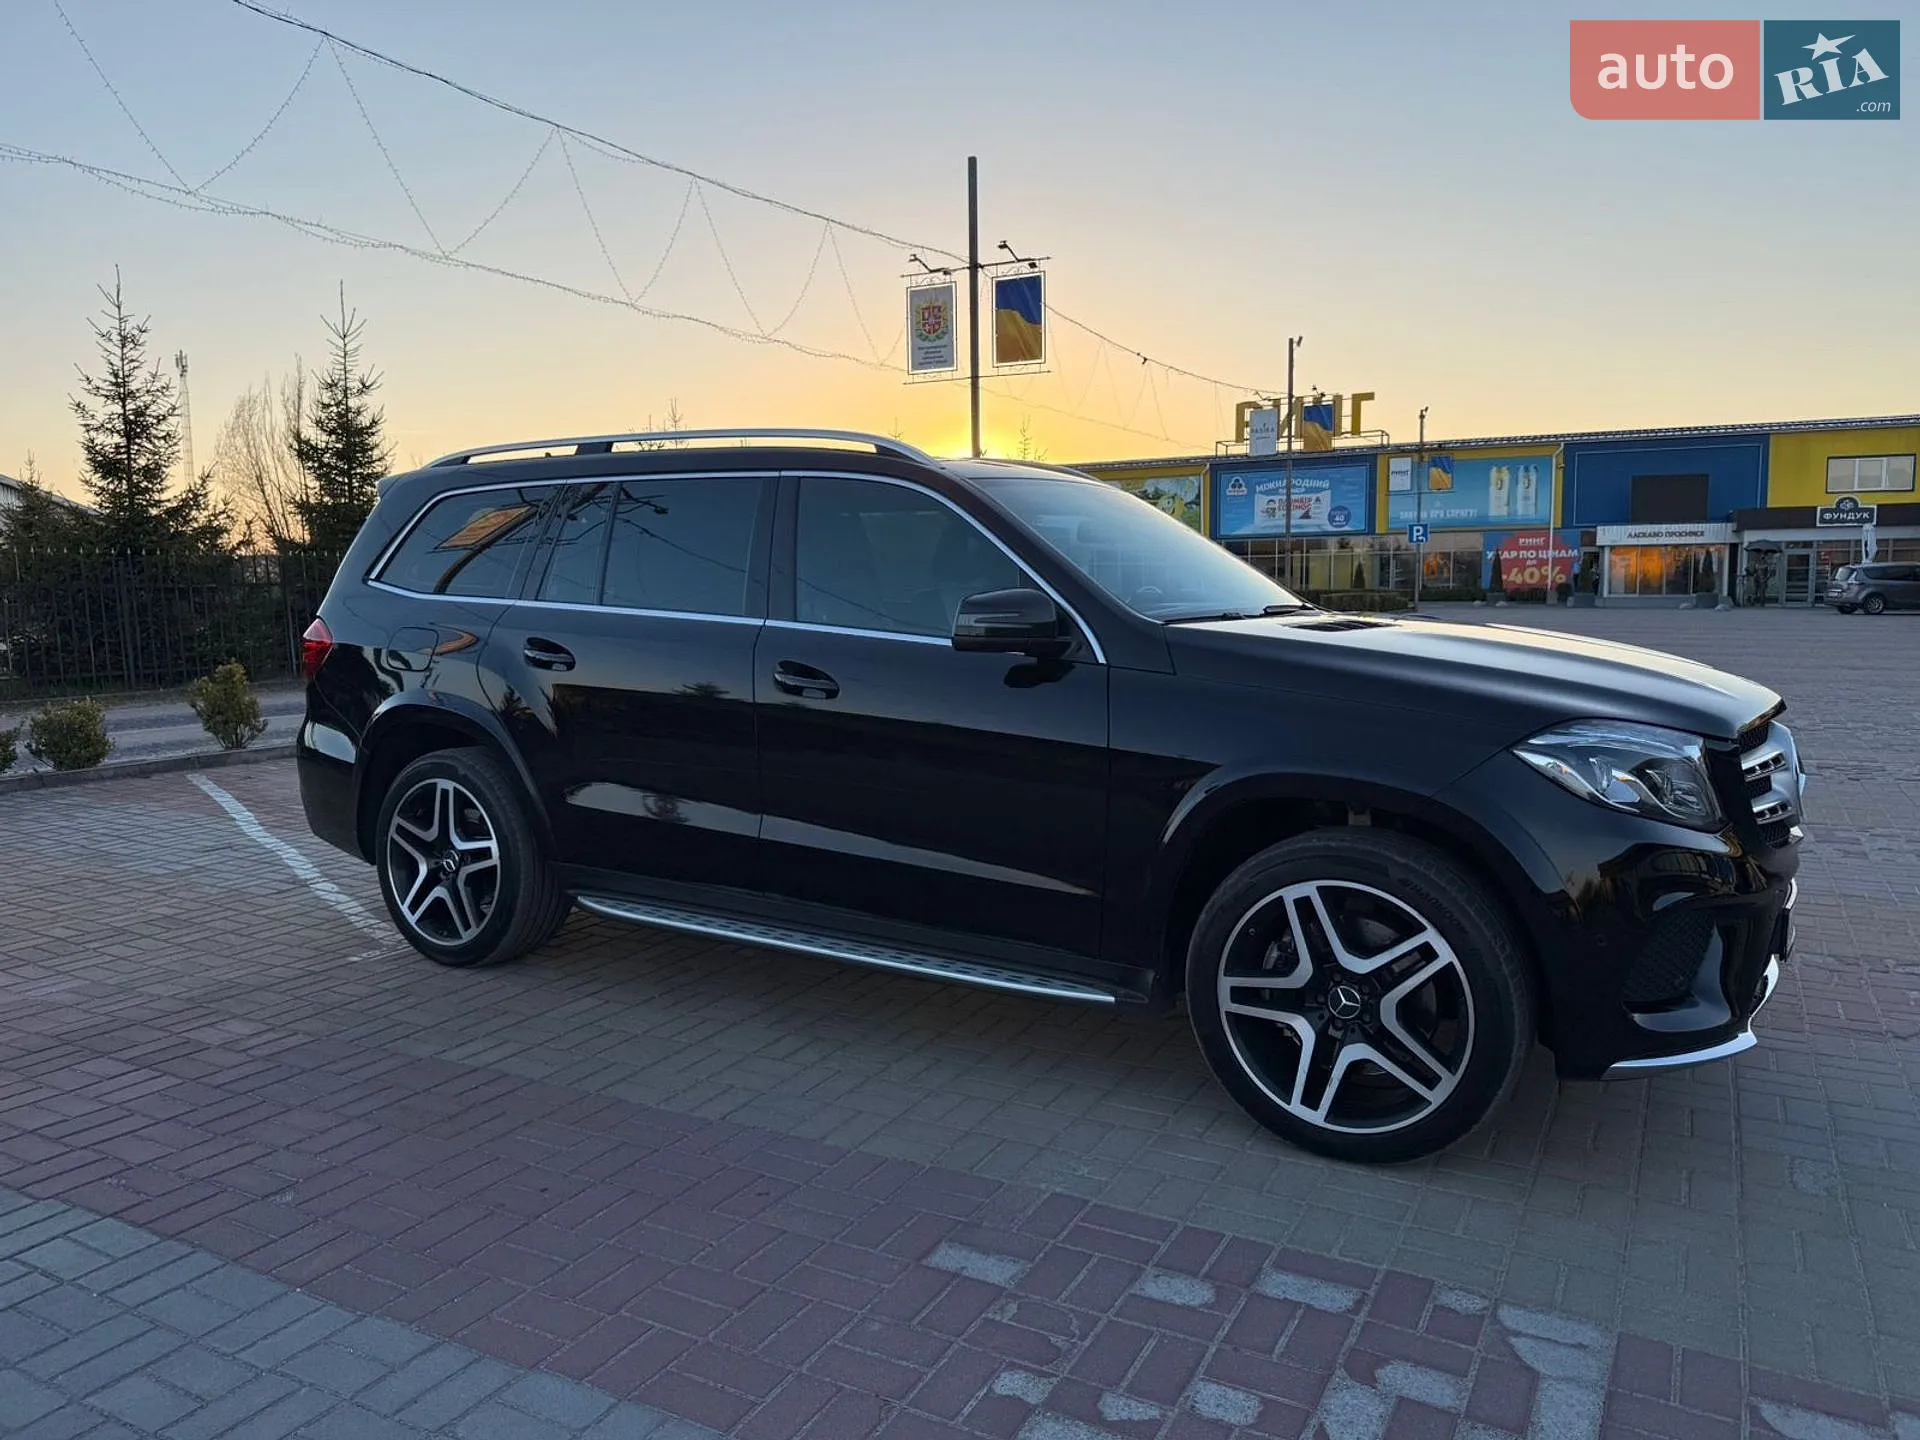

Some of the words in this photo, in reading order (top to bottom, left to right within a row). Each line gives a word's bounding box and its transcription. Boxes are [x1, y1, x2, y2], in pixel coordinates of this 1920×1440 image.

[1823, 511, 1870, 521] ФУНДУК
[1486, 550, 1518, 560] УАР
[1519, 550, 1537, 559] ПО
